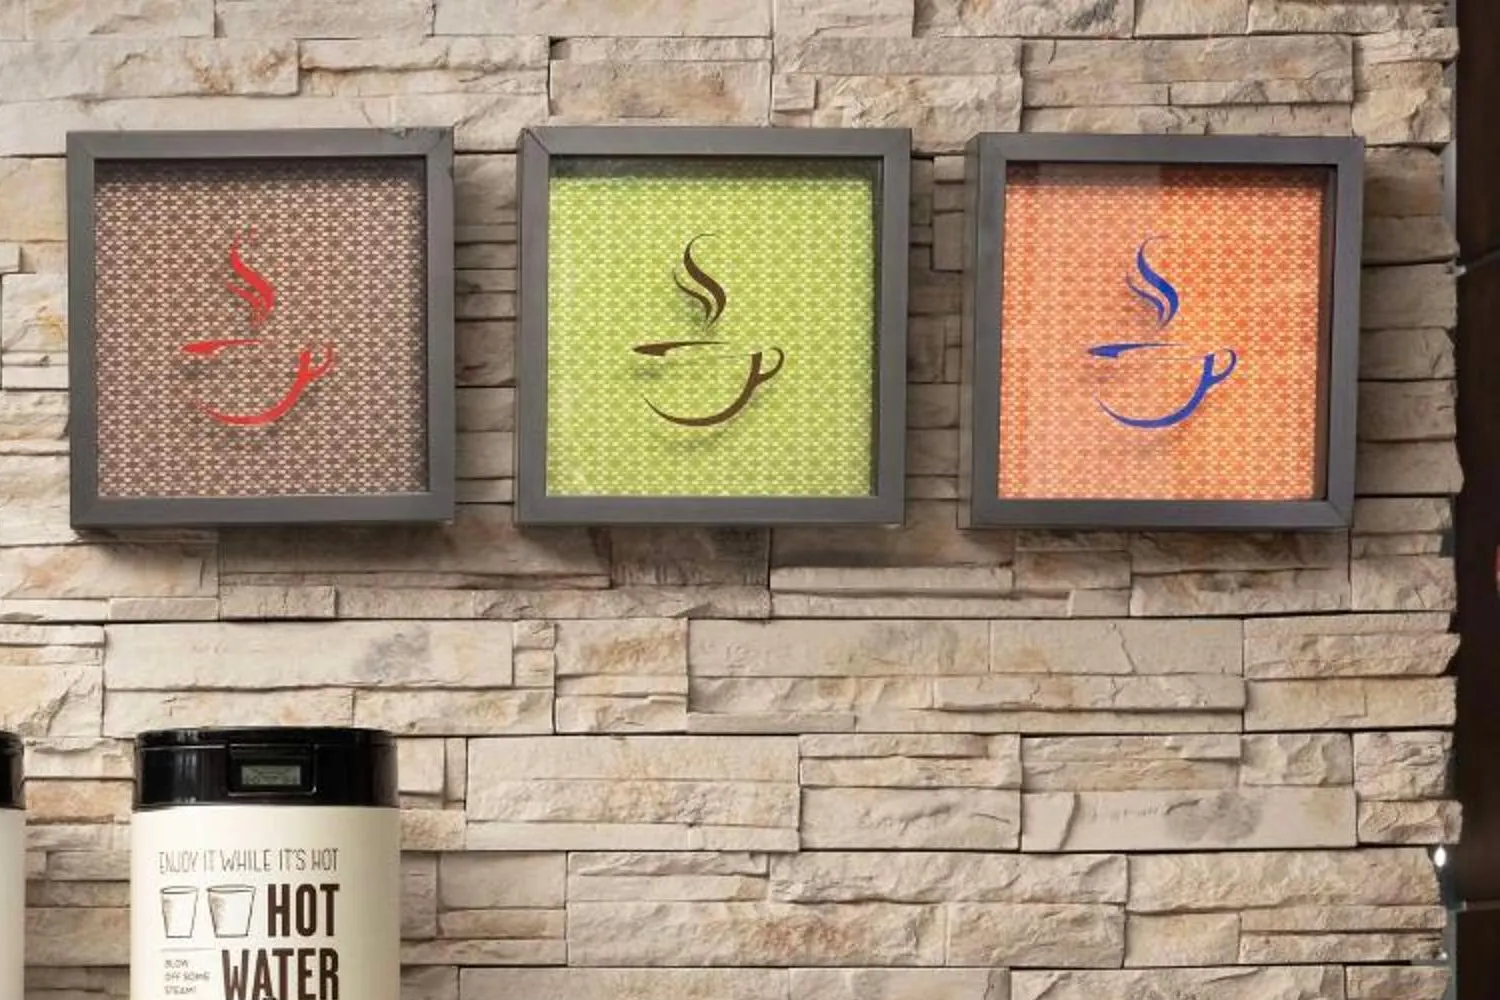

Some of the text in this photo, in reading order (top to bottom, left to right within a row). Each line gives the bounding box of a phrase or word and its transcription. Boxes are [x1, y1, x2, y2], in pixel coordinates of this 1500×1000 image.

[159, 847, 339, 875] ENJOY IT WHILE IT'S HOT
[267, 883, 340, 937] HOT
